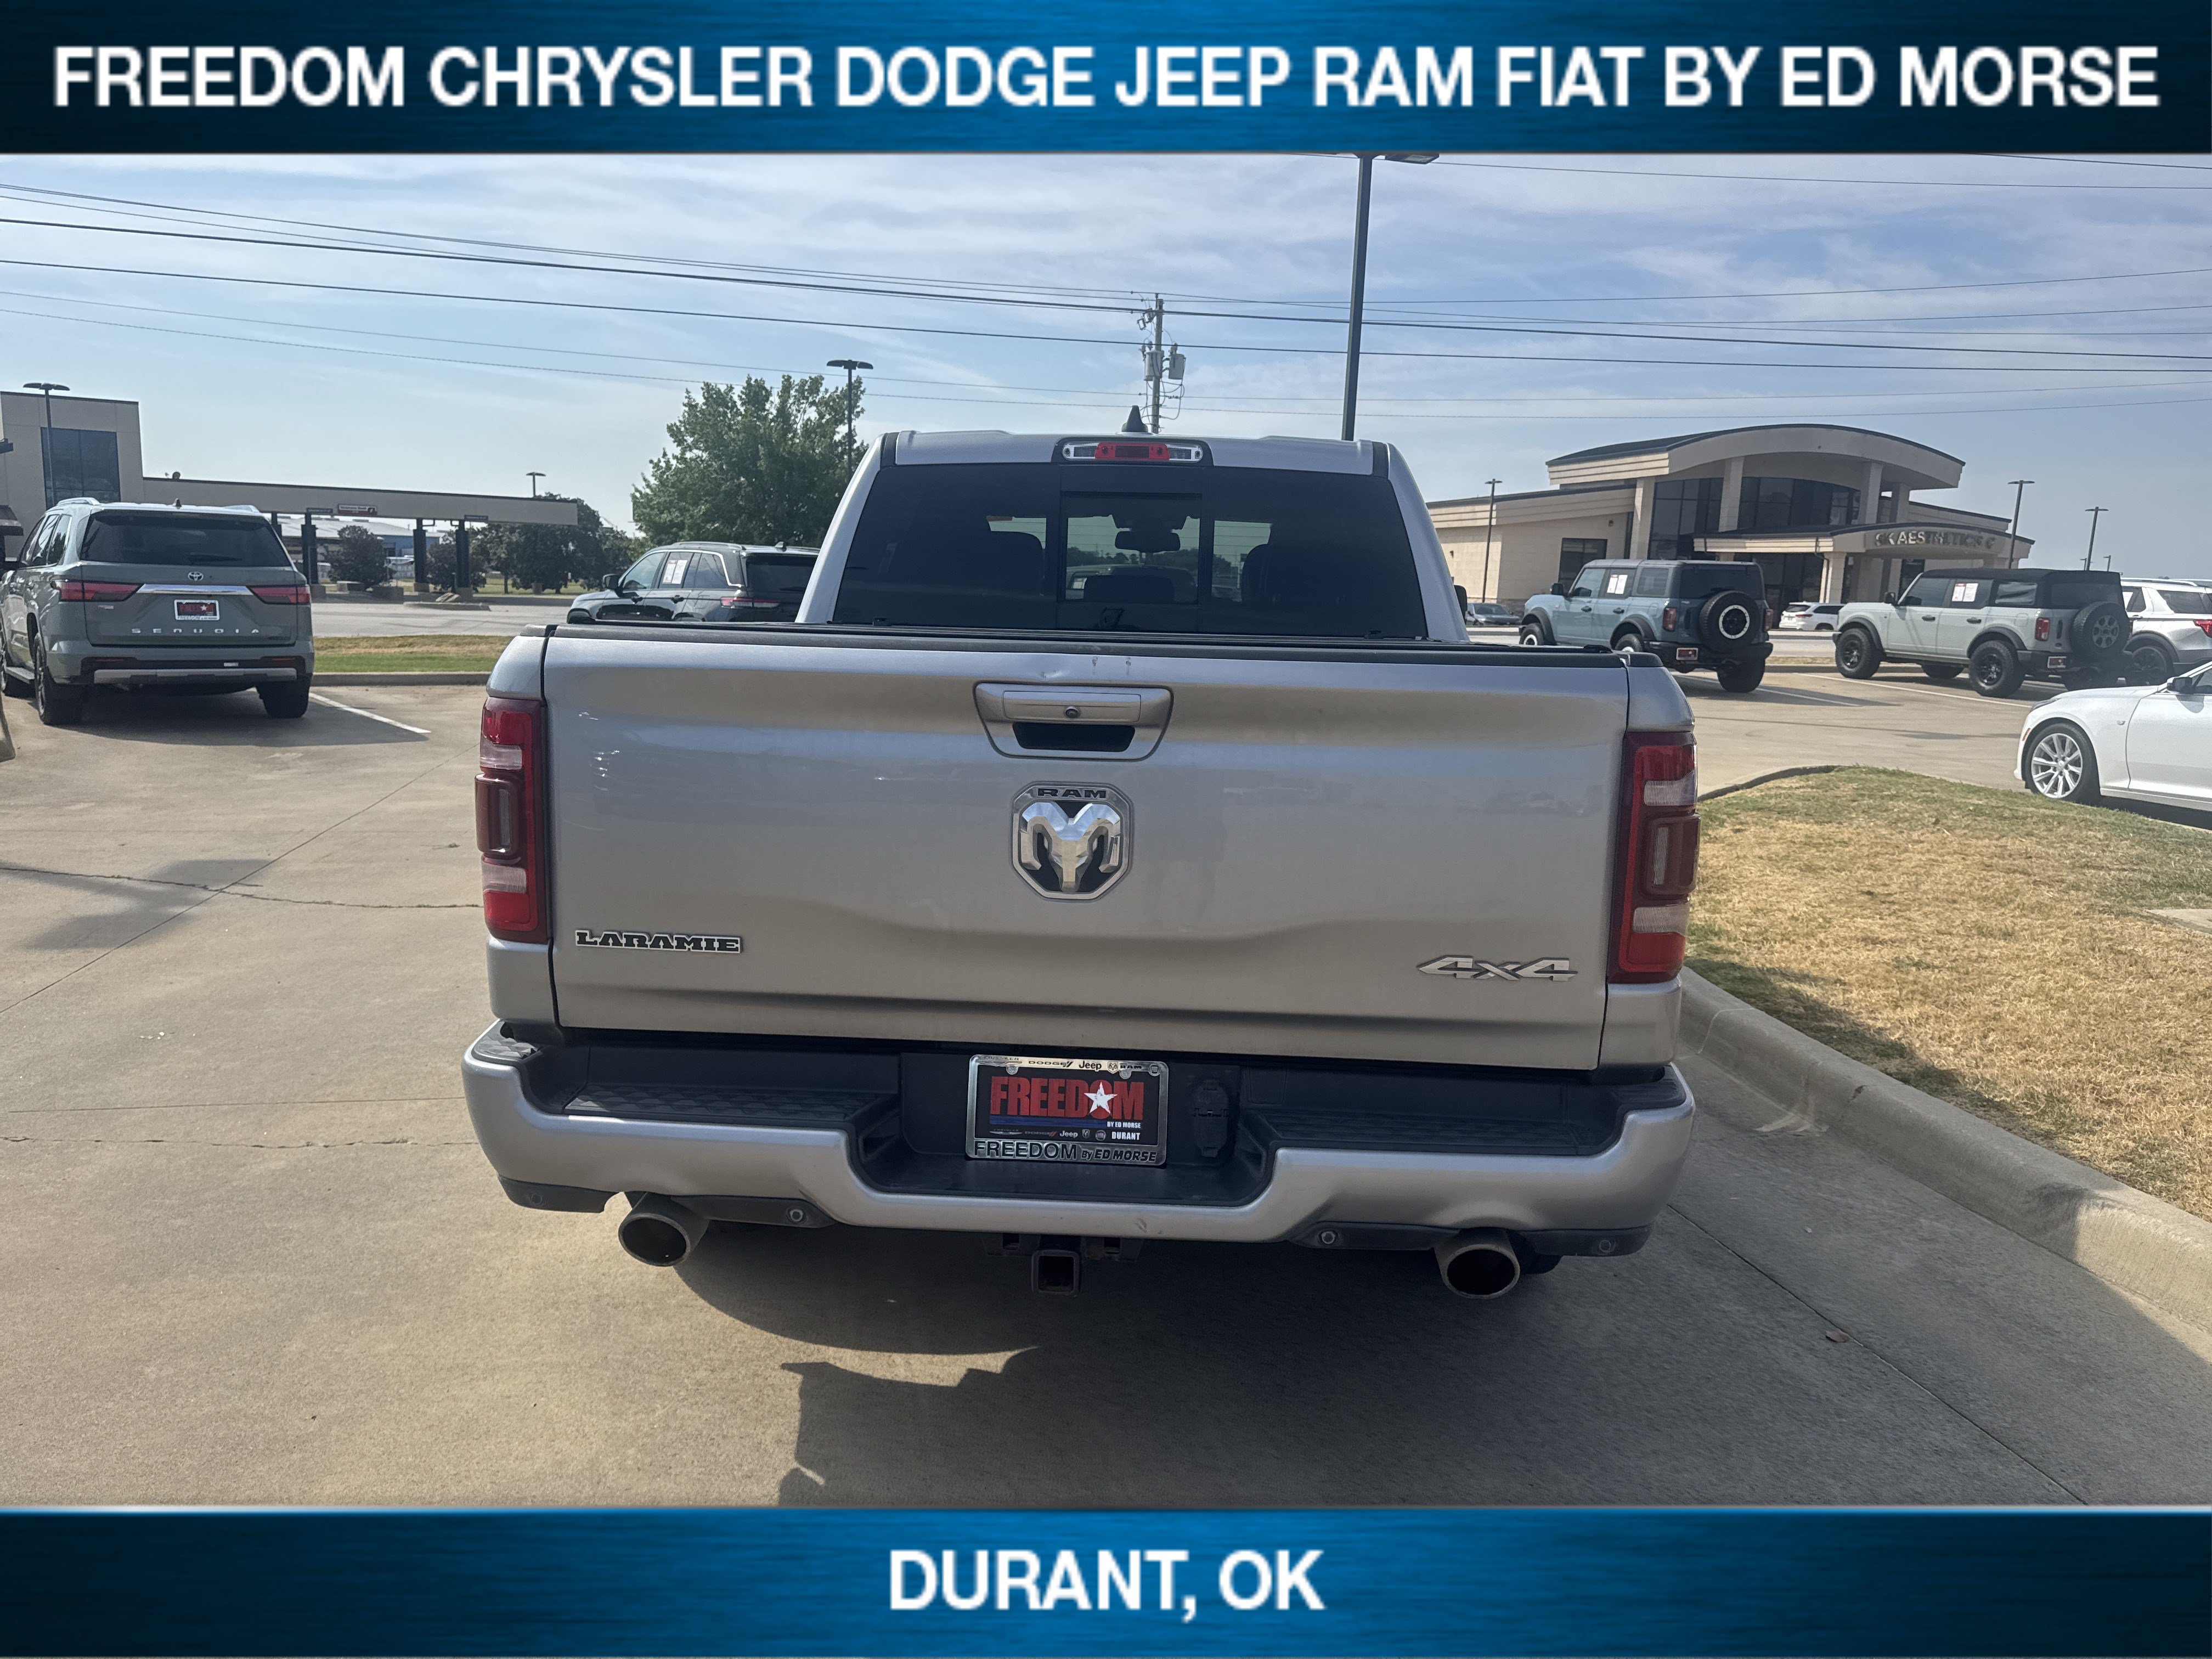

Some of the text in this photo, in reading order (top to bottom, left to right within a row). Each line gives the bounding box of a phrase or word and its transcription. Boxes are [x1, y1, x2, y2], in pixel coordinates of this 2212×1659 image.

[1037, 788, 1107, 799] RAM
[575, 929, 740, 953] LARAMIE
[1079, 1060, 1102, 1070] Jeep
[1059, 1130, 1078, 1138] Jeep
[1111, 1131, 1141, 1140] DURANT
[974, 1141, 1077, 1160] FREEDOM
[1094, 1149, 1111, 1160] ED
[1113, 1150, 1157, 1162] MORSE
